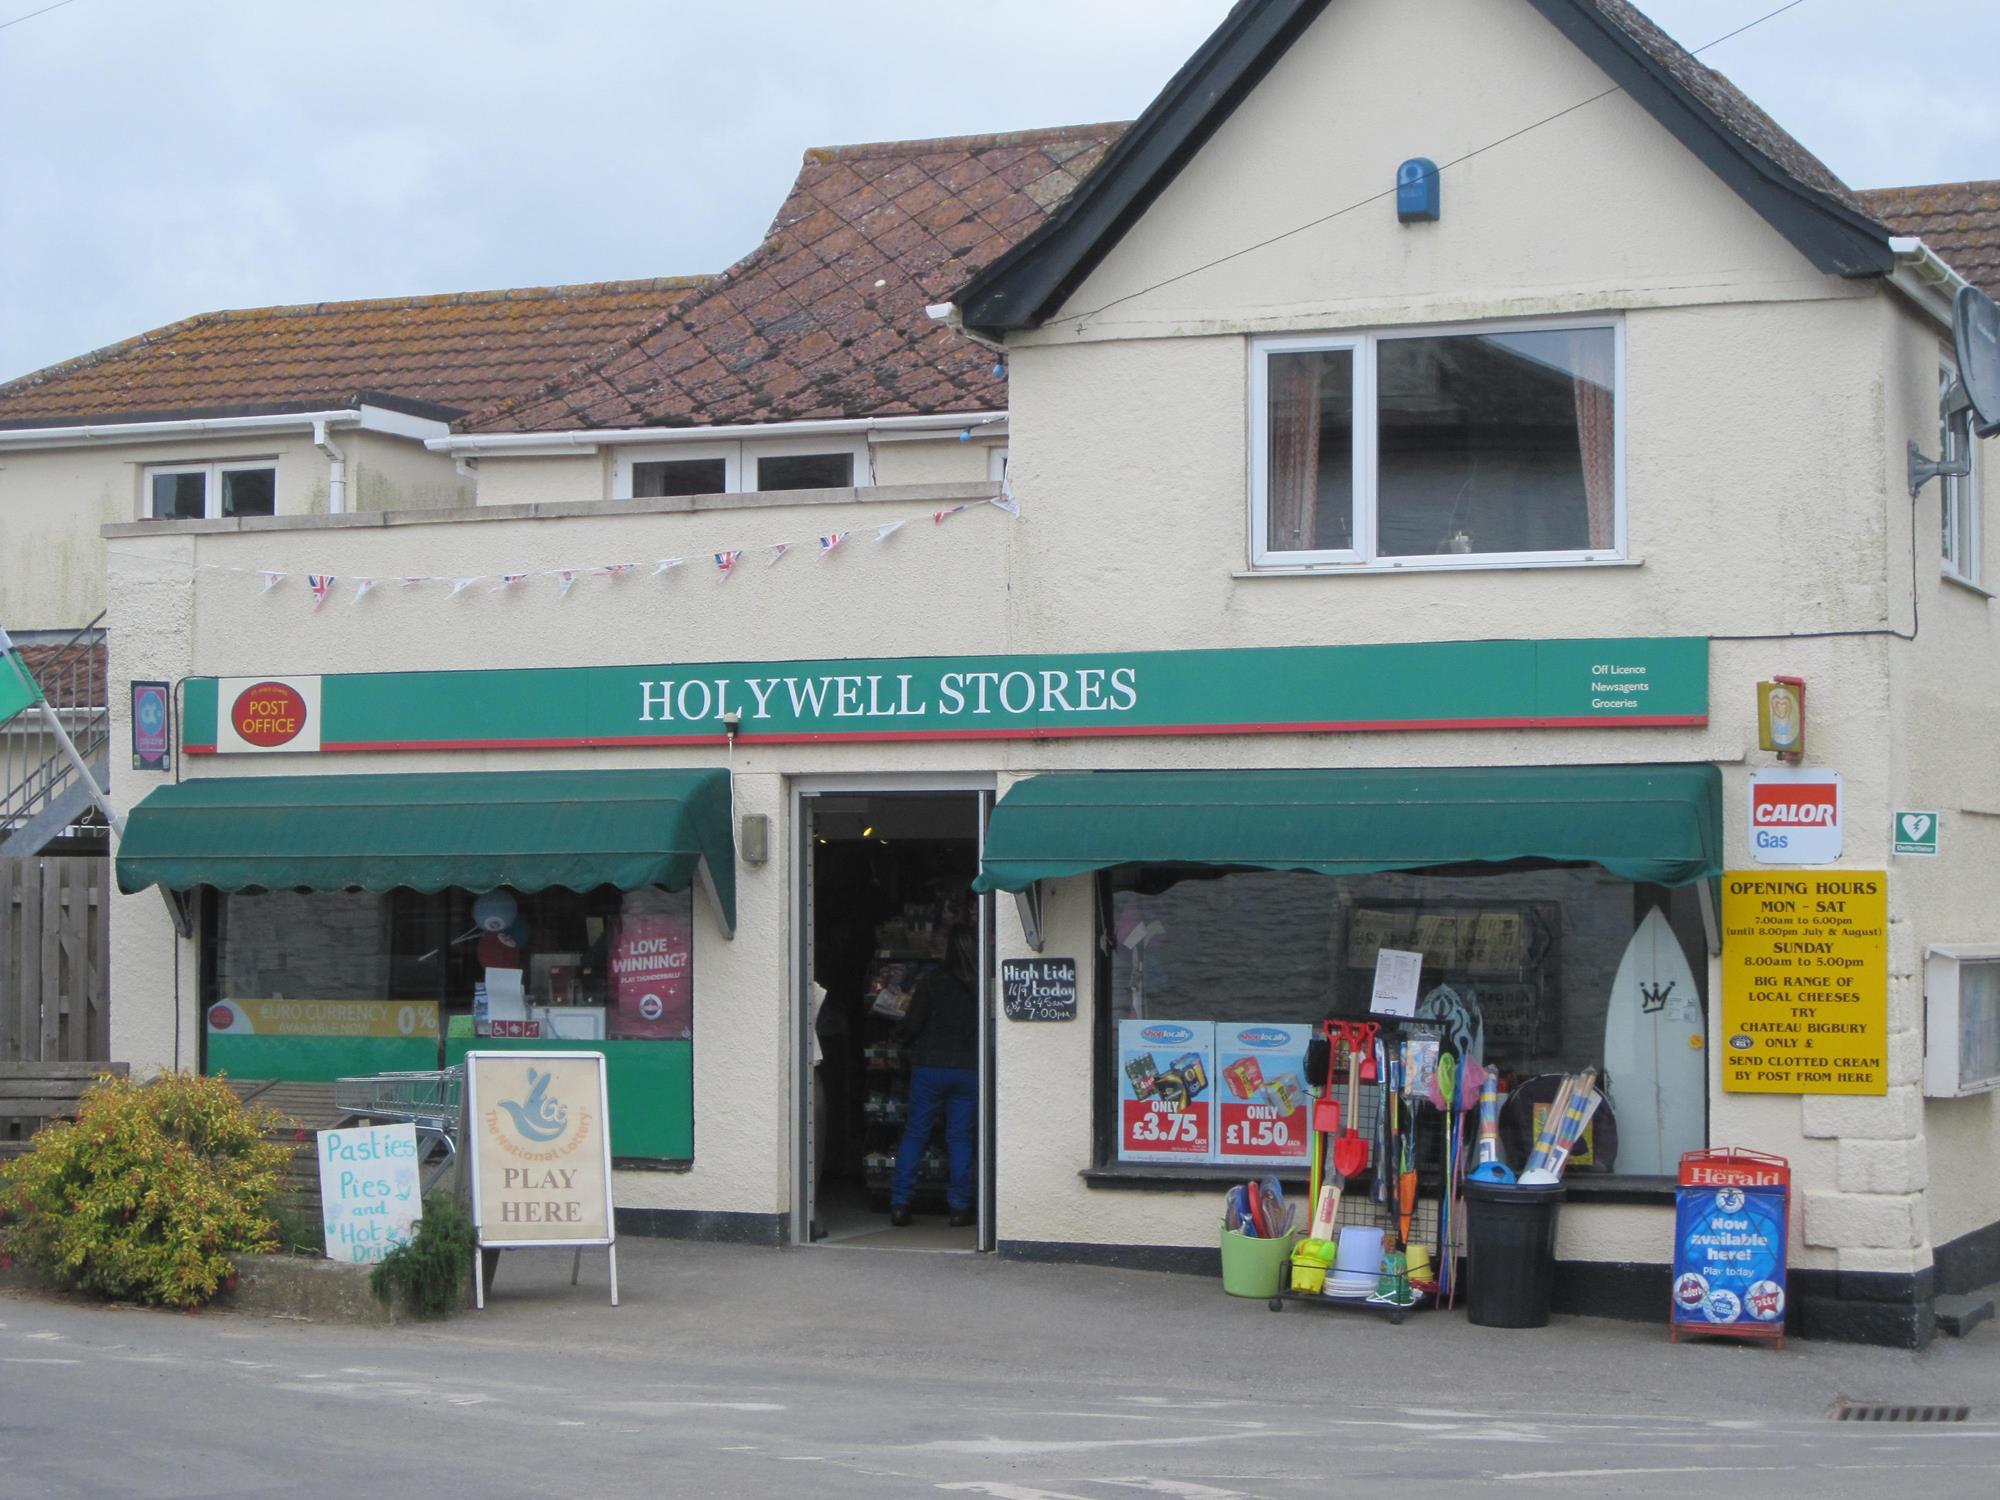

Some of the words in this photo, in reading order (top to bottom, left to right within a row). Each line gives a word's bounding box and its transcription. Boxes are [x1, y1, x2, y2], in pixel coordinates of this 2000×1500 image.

[1592, 665, 1608, 674] Off
[1611, 665, 1646, 674] Licence
[1592, 682, 1649, 693] Newsagents
[639, 675, 926, 721] HOLYWELL
[939, 668, 1137, 714] STORES
[249, 701, 288, 715] POST
[1592, 699, 1638, 708] Groceries
[243, 719, 295, 733] OFFICE
[1756, 804, 1834, 826] CALOR
[1757, 831, 1788, 848] Gas
[1730, 882, 1808, 895] OPENING
[1816, 882, 1877, 895] HOURS
[1761, 901, 1795, 912] MON
[1816, 901, 1846, 912] SAT
[1755, 916, 1792, 925] 7.00am
[1798, 916, 1808, 925] to
[1813, 916, 1852, 926] 6.00pm
[1726, 927, 1754, 936] (until
[1759, 928, 1797, 937] 8.00pm
[1802, 927, 1823, 937] July
[1829, 928, 1837, 936] &
[1841, 928, 1882, 937] August)
[630, 939, 667, 955] LOVE
[1773, 942, 1834, 953] SUNDAY
[612, 953, 687, 973] WINNING?
[1744, 957, 1792, 966] 8.00am
[1798, 957, 1811, 966] to
[1816, 957, 1863, 968] 5.00pm
[1004, 963, 1039, 987] High
[1043, 964, 1075, 981] tide
[1754, 977, 1777, 986] BIG
[1784, 977, 1830, 987] RANGE
[1837, 977, 1854, 987] OF
[1032, 981, 1075, 1004] today
[1749, 992, 1792, 1001] LOCAL
[1798, 992, 1860, 1002] CHEESES
[305, 1004, 389, 1020] CURRENCY
[1791, 1008, 1816, 1017] TRY
[1740, 1022, 1801, 1032] CHATEAU
[1808, 1023, 1867, 1033] BIGBURY
[1765, 1038, 1798, 1048] ONLY
[1729, 1056, 1763, 1066] SEND
[1768, 1056, 1828, 1067] CLOTTED
[1834, 1057, 1879, 1068] CREAM
[1735, 1071, 1752, 1080] BY
[1758, 1072, 1791, 1081] POST
[1796, 1072, 1832, 1082] FROM
[1838, 1073, 1873, 1082] HERE
[1152, 1101, 1179, 1113] ONLY
[1247, 1106, 1278, 1119] ONLY
[1133, 1112, 1198, 1141] £3.75
[1227, 1121, 1288, 1146] £1.50
[327, 1133, 417, 1162] Pasties
[504, 1168, 577, 1189] PLAY
[1692, 1167, 1779, 1186] Herald
[340, 1171, 392, 1200] Pies
[352, 1201, 389, 1216] and
[501, 1201, 582, 1222] HERE
[1712, 1217, 1748, 1230] Now
[340, 1220, 382, 1244] Hot
[1691, 1233, 1768, 1246] available
[1707, 1247, 1751, 1260] here!
[1703, 1266, 1722, 1277] Play
[1726, 1266, 1755, 1277] today
